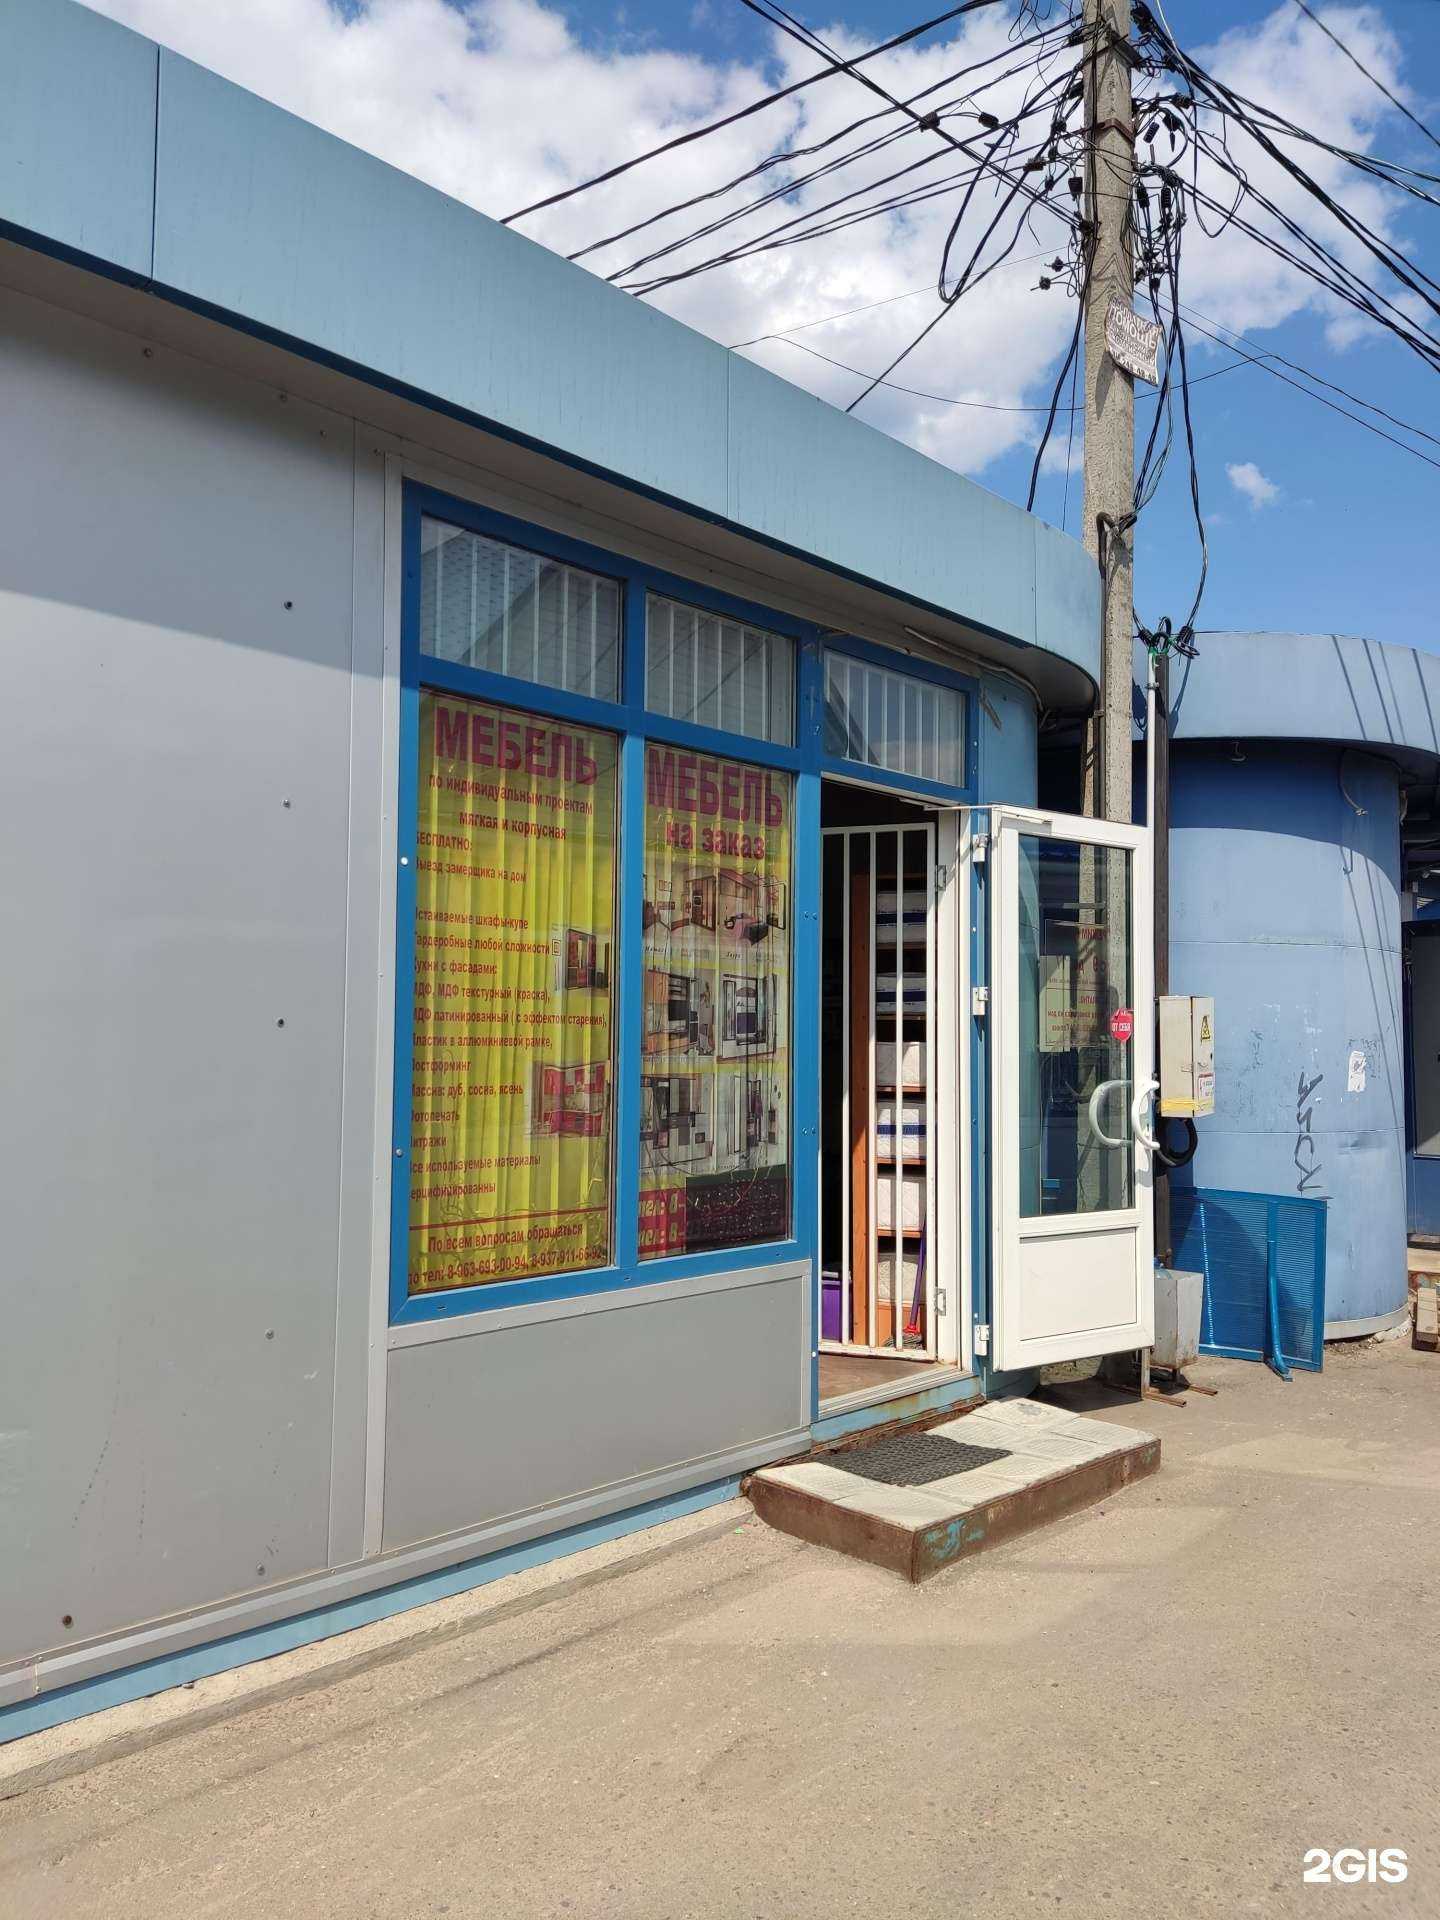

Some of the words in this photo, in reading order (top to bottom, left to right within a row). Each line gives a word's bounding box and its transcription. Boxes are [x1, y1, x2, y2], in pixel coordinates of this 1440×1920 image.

[1107, 304, 1157, 350] ПОМОЩЬ
[435, 705, 597, 785] МЕБЕЛЬ
[429, 774, 443, 790] по
[447, 778, 543, 807] индивидуальным
[545, 795, 593, 815] проектам
[647, 747, 783, 827] МЕБЕЛЬ
[459, 811, 499, 829] мягкая
[502, 819, 509, 830] и
[511, 820, 567, 840] корпусная
[666, 821, 694, 850] на
[702, 827, 765, 860] заказ
[446, 863, 496, 880] замерщика
[498, 869, 508, 880] на
[510, 871, 527, 883] дом
[475, 913, 529, 931] шкафы-купе
[415, 931, 473, 949] ардеробные
[474, 938, 503, 951] любой
[506, 941, 550, 955] сложности
[441, 962, 447, 972] с
[450, 959, 498, 977] фасадами:
[438, 983, 459, 1000] МДФ
[462, 985, 512, 1003] текстурный
[434, 1008, 509, 1025] патинированный
[516, 1013, 522, 1023] с
[523, 1012, 566, 1027] эффектом
[457, 1035, 522, 1049] аллюминиевой
[525, 1036, 553, 1050] рамке,
[499, 1085, 524, 1095] ясень
[411, 1109, 460, 1123] отопечать
[410, 1135, 447, 1150] итражи
[410, 1160, 423, 1174] се
[426, 1157, 493, 1174] используемые
[494, 1153, 541, 1169] материалы
[427, 1236, 442, 1253] По
[446, 1233, 473, 1250] всем
[475, 1230, 524, 1250] вопросам
[527, 1223, 583, 1242] обращаться
